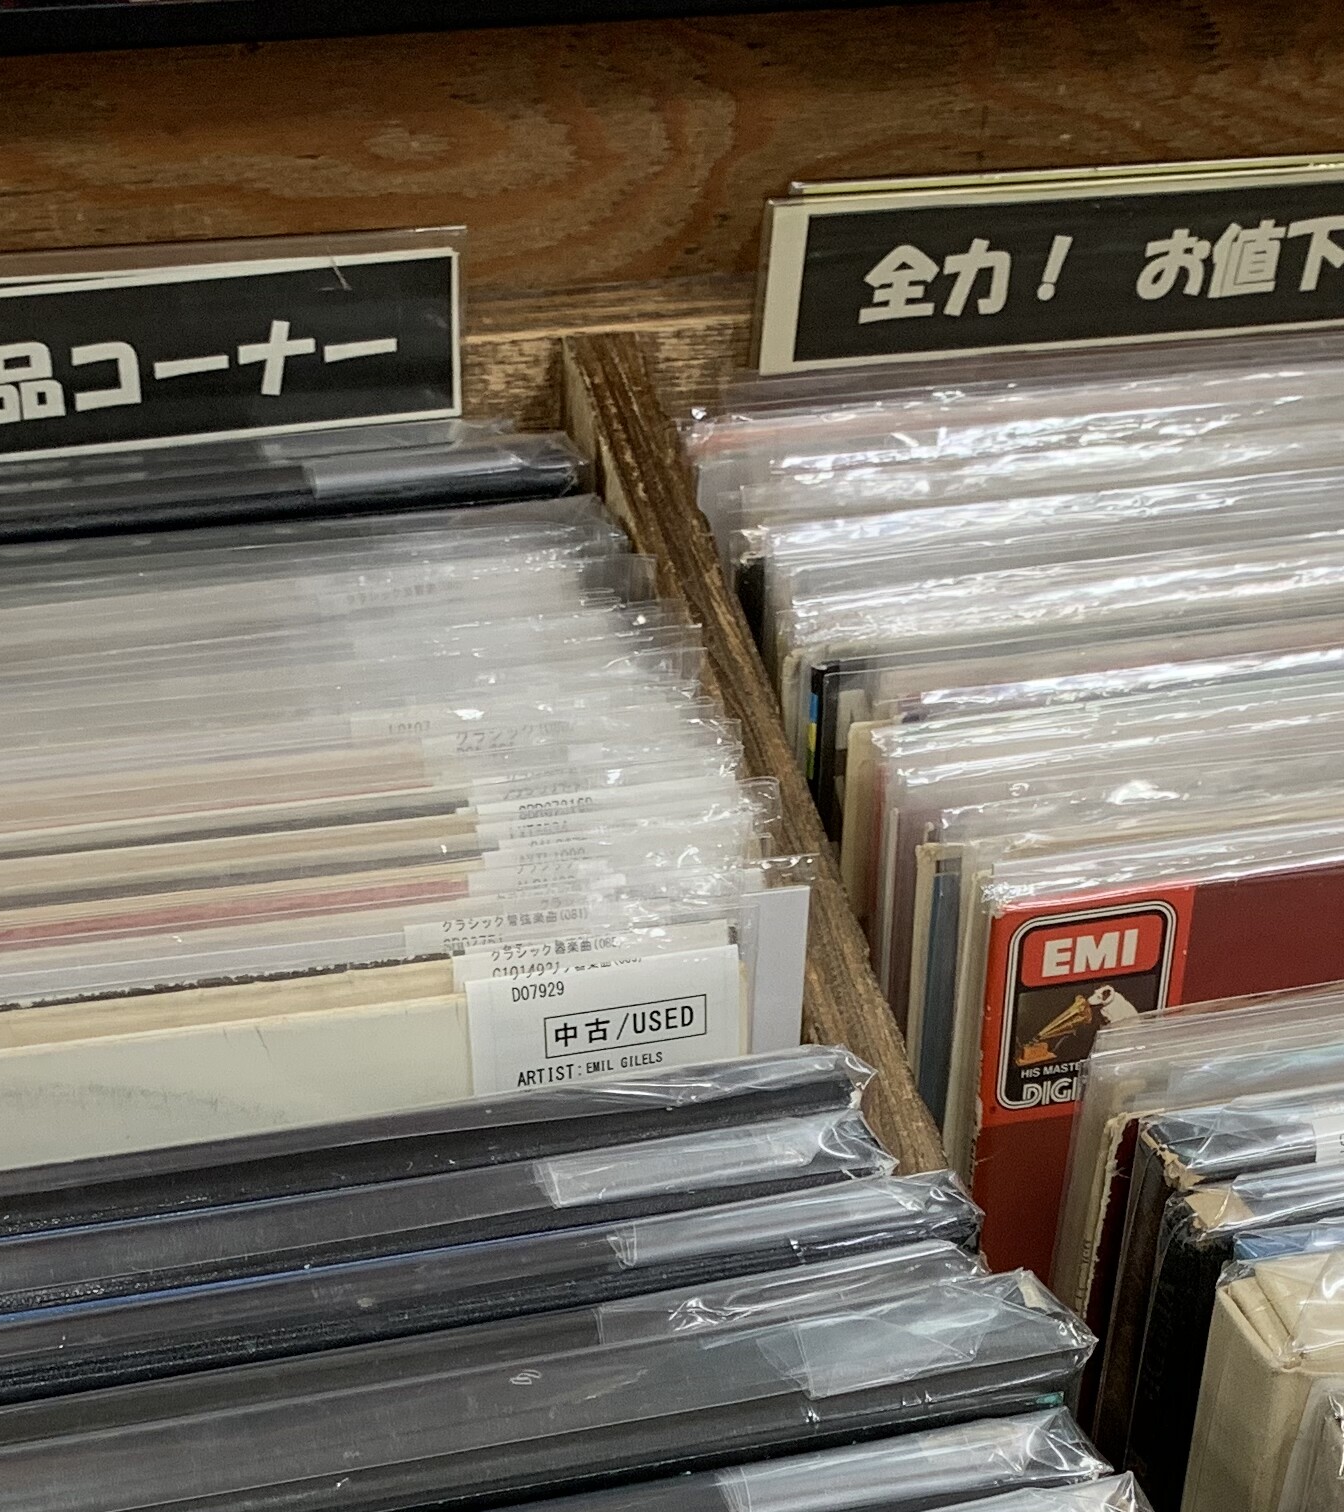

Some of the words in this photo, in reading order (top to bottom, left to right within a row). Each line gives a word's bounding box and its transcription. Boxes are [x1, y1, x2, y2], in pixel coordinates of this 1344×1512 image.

[858, 235, 1072, 324] 全力！
[1041, 928, 1139, 978] EMI
[511, 981, 565, 1003] D07929
[554, 1005, 695, 1048] 中古/USED
[586, 1058, 614, 1074] EMIL
[621, 1051, 664, 1069] GILELS
[1020, 1067, 1041, 1079] HIS
[1022, 1078, 1079, 1105] DIGI
